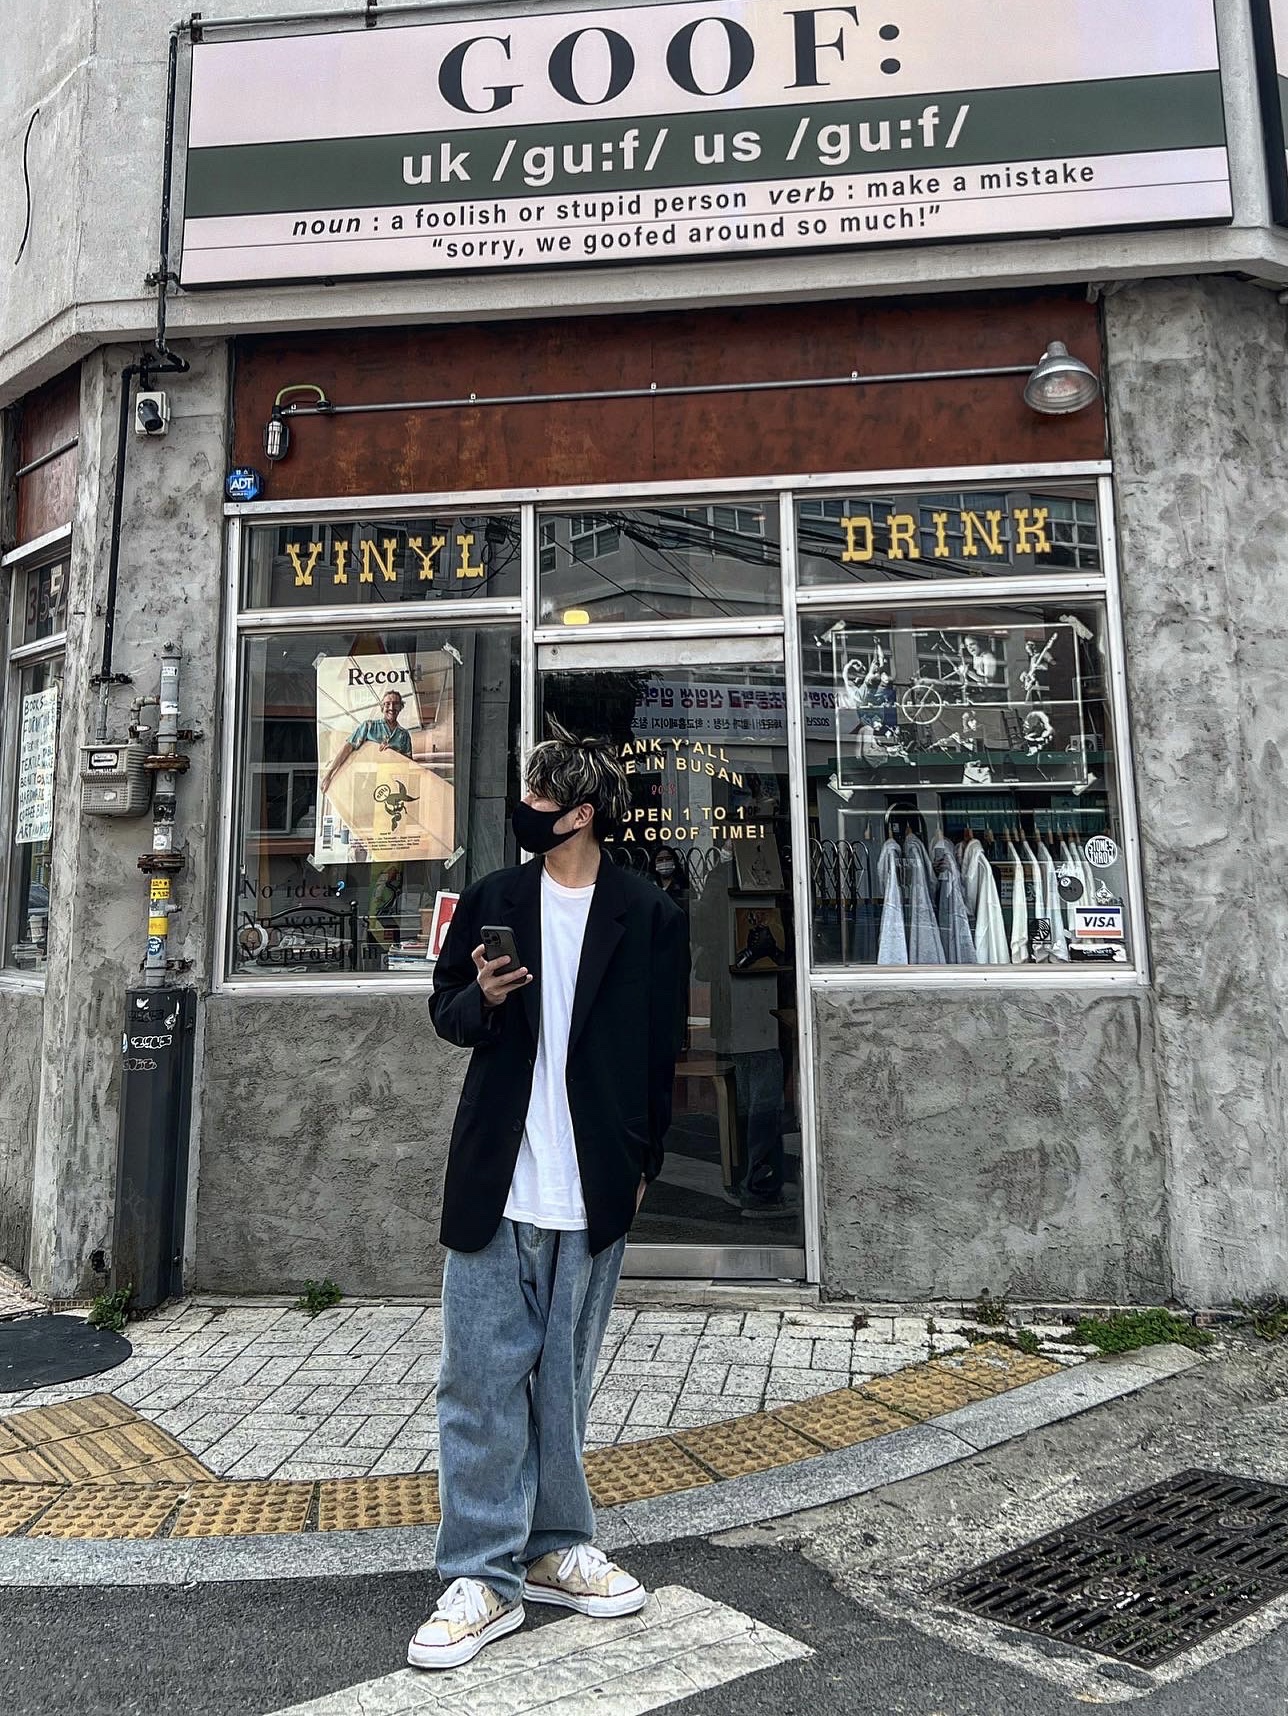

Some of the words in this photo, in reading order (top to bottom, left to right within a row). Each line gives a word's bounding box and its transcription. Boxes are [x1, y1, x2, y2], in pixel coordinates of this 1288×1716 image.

[438, 5, 901, 114] GOOF:
[402, 142, 471, 185] uk
[492, 128, 669, 187] /gu:f/
[694, 131, 762, 164] us
[785, 104, 969, 166] /gu:f/
[292, 216, 361, 236] noun
[391, 214, 404, 230] a
[415, 204, 506, 229] foolish
[519, 205, 545, 222] or
[556, 194, 641, 222] stupid
[654, 190, 746, 218] person
[769, 180, 834, 206] verb
[867, 174, 940, 198] make
[953, 175, 966, 192] a
[980, 162, 1094, 190] mistake
[432, 238, 524, 260] “sorry,
[536, 235, 572, 252] we
[583, 223, 676, 254] goofed
[688, 216, 785, 243] around
[797, 218, 828, 235] so
[840, 205, 940, 233] much!”
[230, 477, 254, 490] ADT
[840, 507, 1052, 563] DRINK
[287, 533, 484, 586] VINYL
[620, 739, 662, 758] ANK
[672, 738, 730, 763] Y’ALL
[646, 756, 665, 771] IN
[676, 757, 743, 788] BUSAN
[622, 807, 673, 823] OPEN
[683, 807, 691, 821] 1
[701, 806, 726, 821] TO
[736, 805, 745, 820] 1
[623, 827, 636, 842] A
[644, 826, 700, 841] GOOF
[709, 824, 765, 840] TIME!
[243, 879, 273, 899] No
[1083, 916, 1116, 928] VISA
